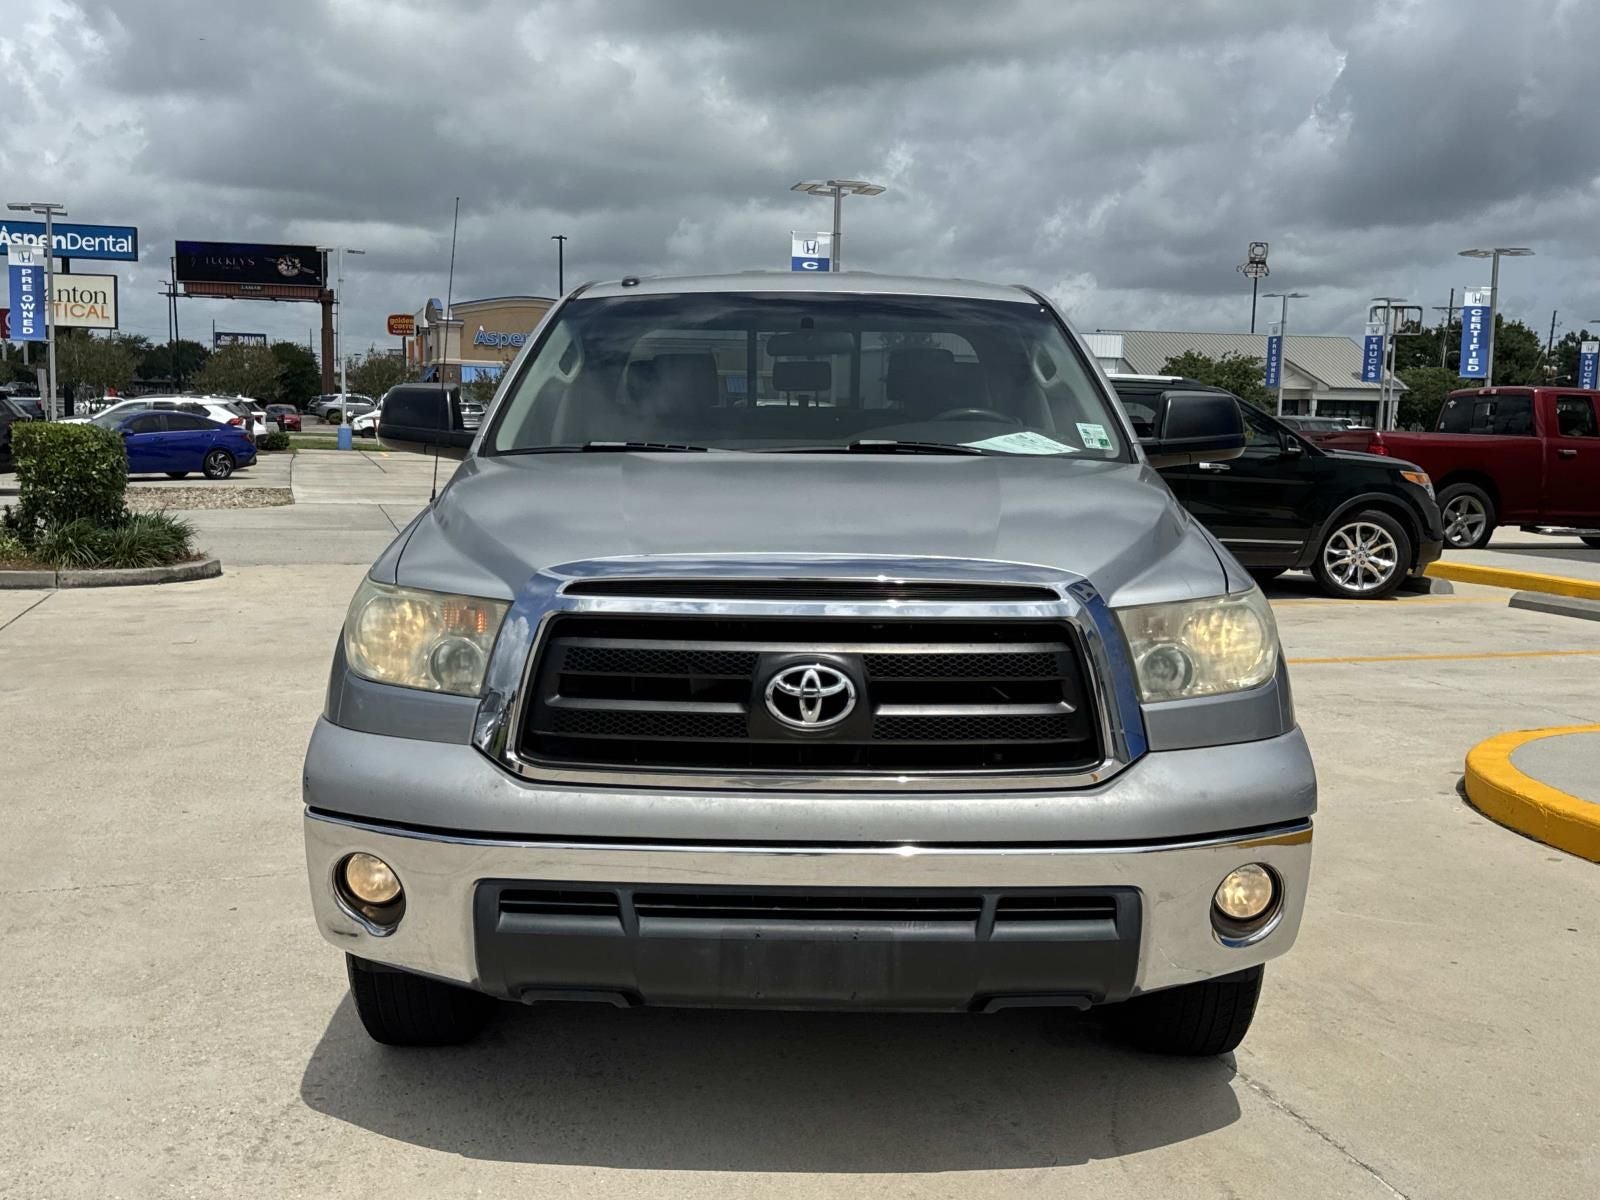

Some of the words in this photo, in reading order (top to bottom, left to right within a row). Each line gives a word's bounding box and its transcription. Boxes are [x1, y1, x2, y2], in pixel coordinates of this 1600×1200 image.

[21, 268, 33, 292] PRE
[44, 286, 107, 304] nton
[21, 294, 35, 335] OWNED
[53, 303, 110, 320] TICAL
[474, 325, 528, 348] Aspe
[1467, 309, 1482, 372] CERTIFIED
[1367, 336, 1378, 378] TRUCKS
